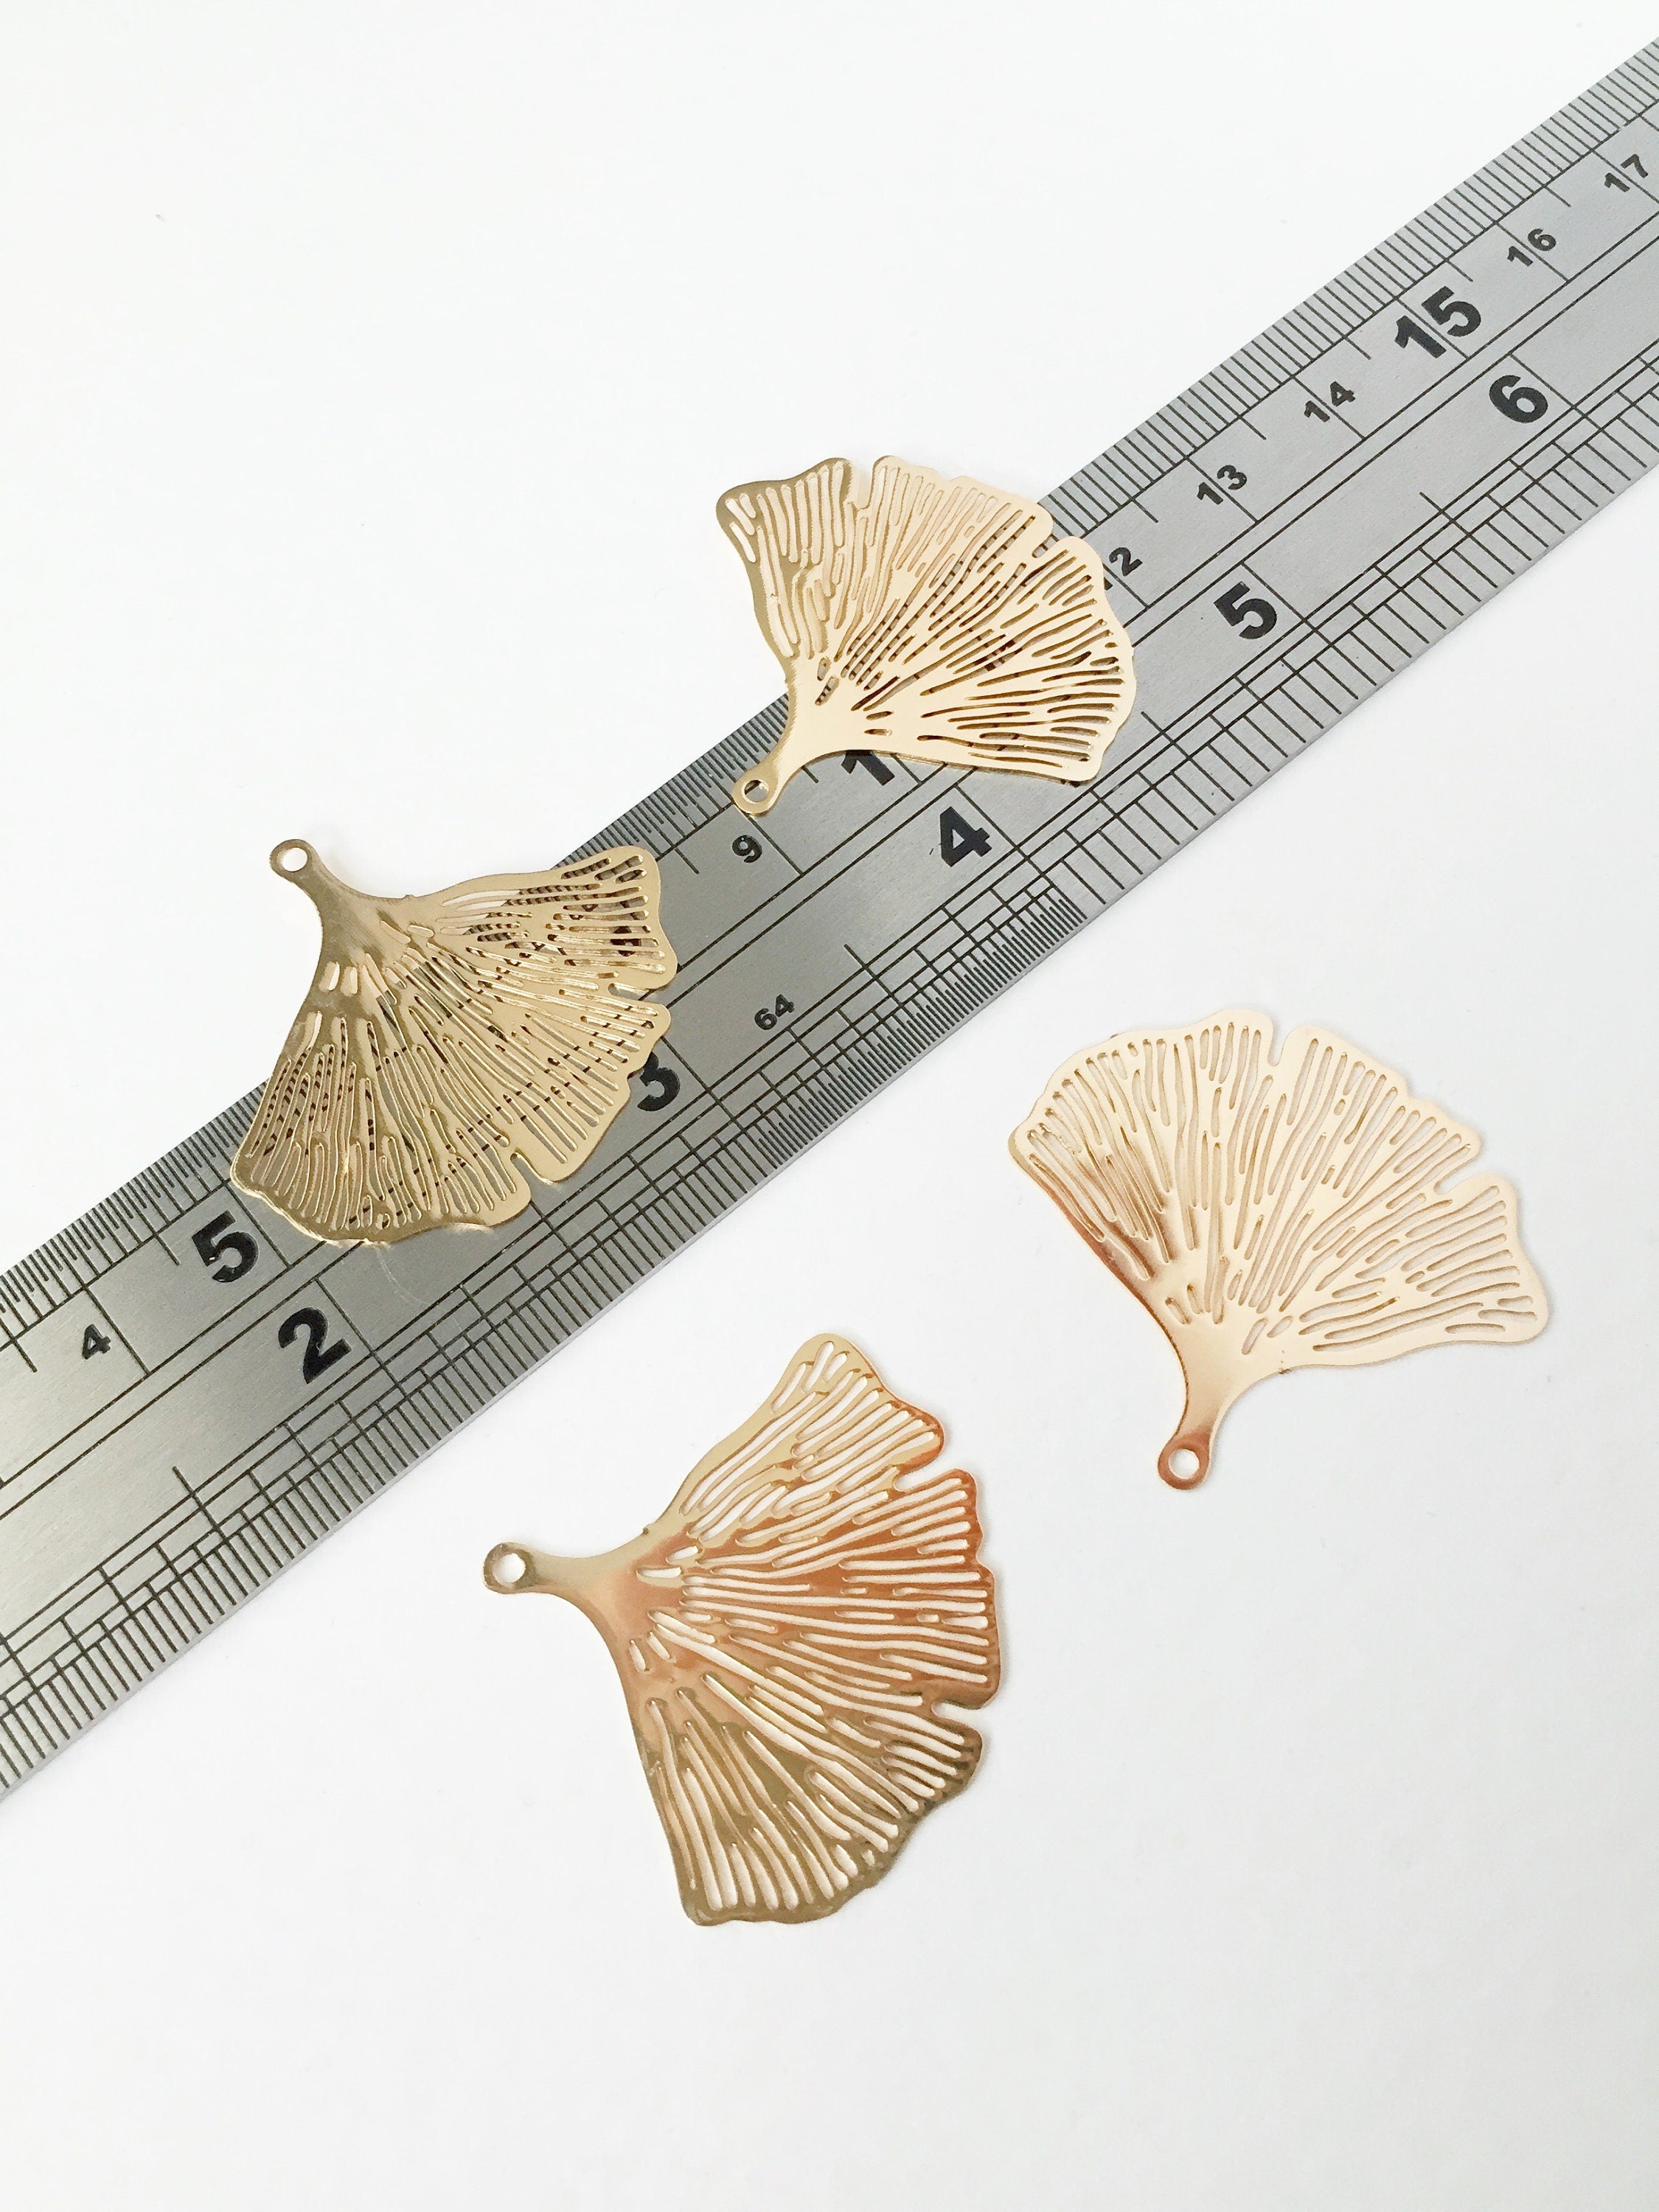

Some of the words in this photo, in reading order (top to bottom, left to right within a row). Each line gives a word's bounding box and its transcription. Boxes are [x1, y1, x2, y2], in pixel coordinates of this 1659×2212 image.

[1604, 154, 1648, 192] 17
[1507, 229, 1557, 266] 16
[1394, 286, 1481, 358] 15
[1304, 380, 1356, 422] 14
[1489, 375, 1548, 423] 6
[1196, 465, 1248, 505] 13
[1104, 546, 1143, 590] 2
[1213, 581, 1278, 639] 5
[731, 835, 762, 863] 9
[940, 806, 992, 867] 4
[754, 994, 795, 1030] 64
[191, 1211, 259, 1283] 5
[82, 1324, 111, 1359] 4
[278, 1307, 352, 1384] 2
